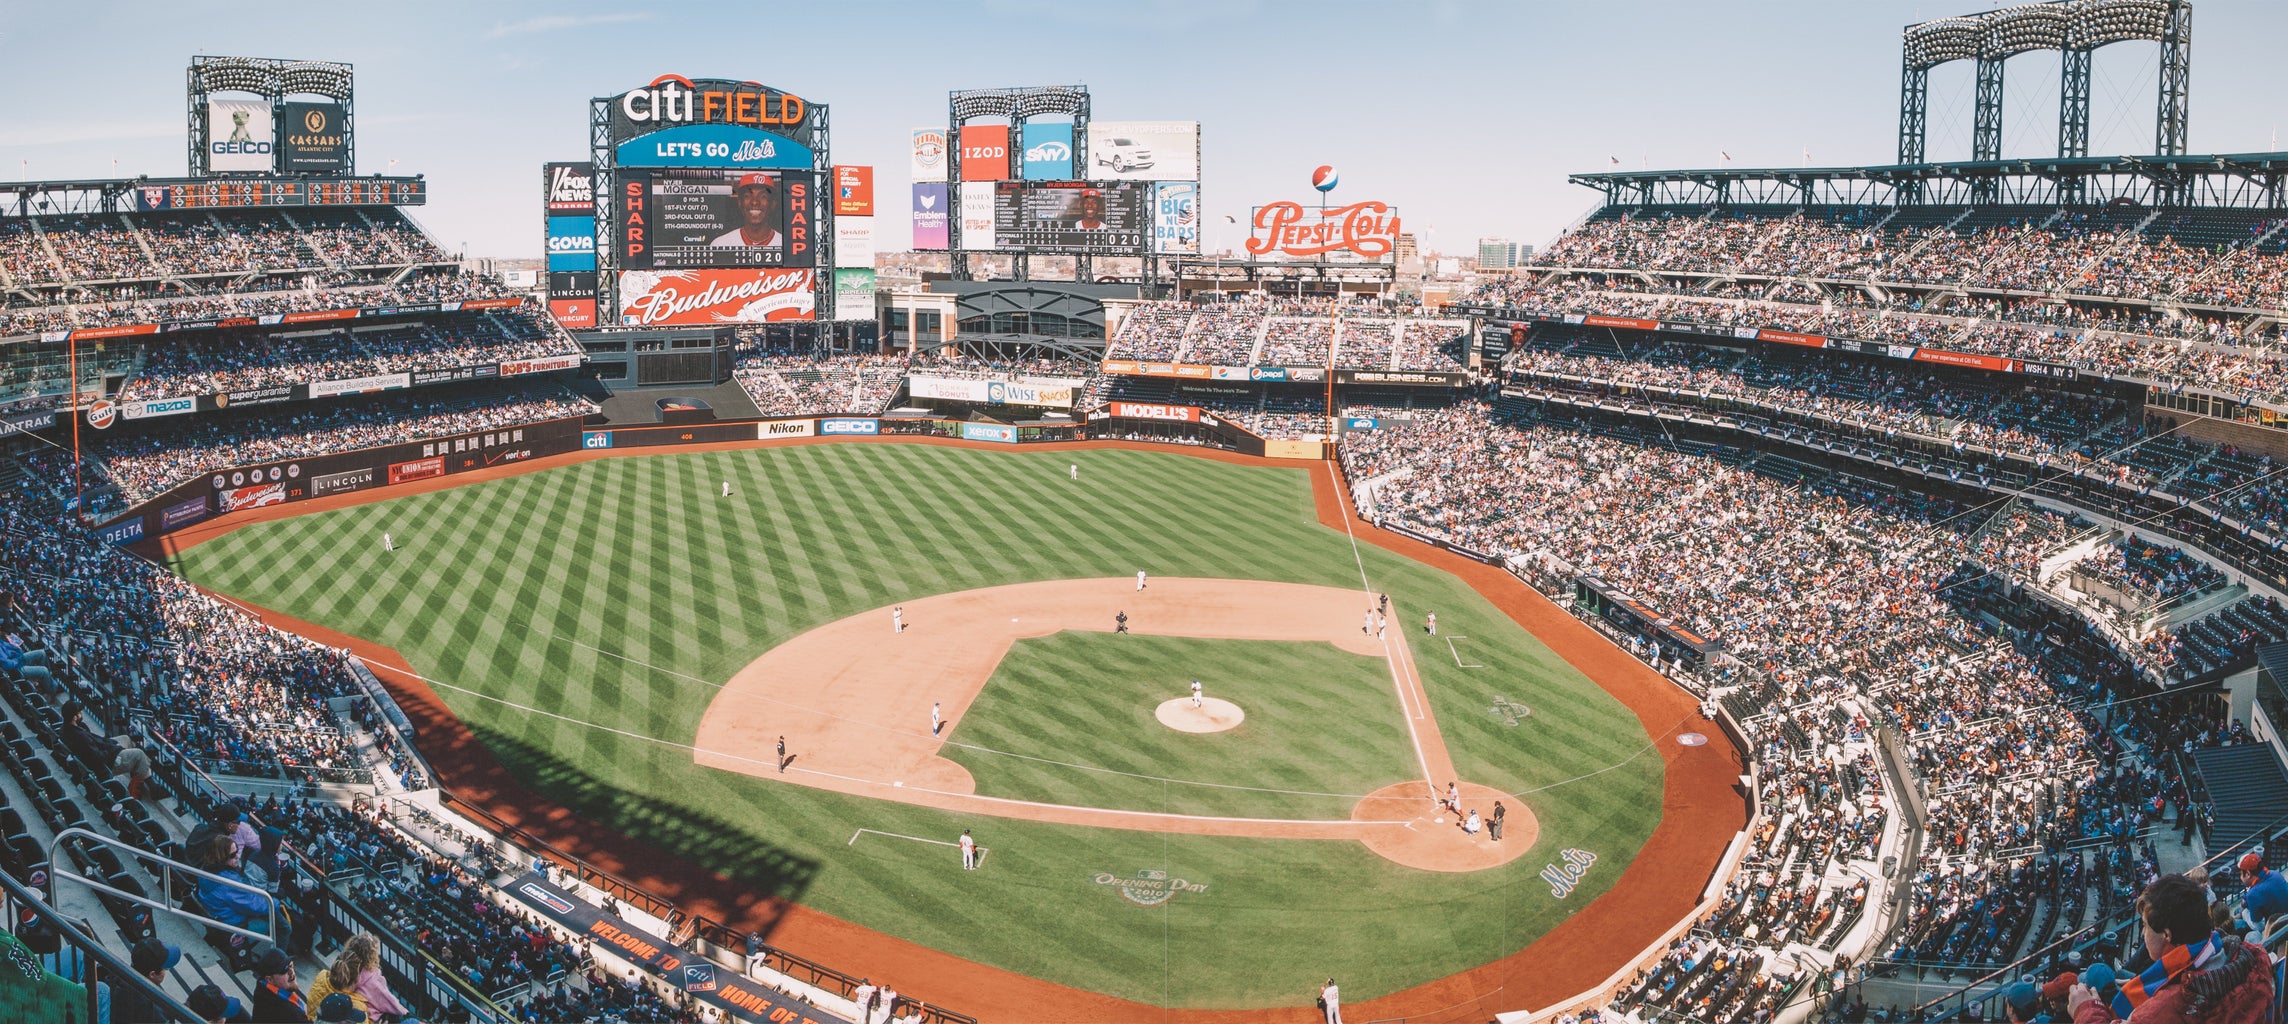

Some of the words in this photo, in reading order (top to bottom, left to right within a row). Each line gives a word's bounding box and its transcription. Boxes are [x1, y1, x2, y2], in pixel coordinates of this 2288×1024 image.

[622, 80, 693, 122] citi
[703, 91, 805, 125] FIELD
[289, 135, 342, 146] CAESARS
[916, 133, 943, 146] TITAN
[212, 141, 271, 154] GEICO
[657, 142, 701, 157] LET'S
[706, 143, 729, 157] GO
[732, 139, 776, 161] Mets
[964, 146, 1005, 159] IZOD
[1025, 147, 1067, 162] SNY
[564, 176, 591, 190] FOX
[663, 185, 709, 194] MORGAN
[556, 189, 592, 201] NEWS
[1161, 198, 1192, 215] BIG
[626, 182, 645, 257] SHARP
[790, 183, 807, 256] SHARP
[913, 211, 947, 220] Emblem
[917, 219, 943, 228] Health
[1157, 226, 1195, 239] BARS
[549, 236, 593, 250] GOYA
[1109, 234, 1116, 245] 0
[1121, 234, 1128, 245] 2
[1132, 234, 1140, 245] 0
[755, 252, 761, 262] 0
[765, 252, 772, 262] 2
[775, 252, 782, 262] 0
[552, 289, 594, 297] LINCOLN
[634, 270, 804, 324] Budweiser
[557, 314, 590, 322] MERCURY
[501, 362, 531, 376] BOB'S
[532, 360, 570, 371] FURNITURE
[1105, 363, 1136, 371] SUBWAY
[1176, 367, 1208, 376] SUBWAY
[1262, 370, 1284, 379] pepsi
[2025, 364, 2042, 374] WSH
[2042, 365, 2048, 374] 4
[2053, 367, 2064, 377] NY
[2068, 368, 2073, 377] 3
[453, 371, 460, 379] At
[462, 371, 472, 379] Bat
[317, 381, 344, 393] Alliance
[346, 379, 374, 391] Building
[375, 376, 404, 387] Services
[228, 386, 292, 401] superguarantee
[939, 390, 970, 398] DONUTS
[146, 399, 191, 414] mazda
[1120, 404, 1189, 420] MODELL'S
[90, 407, 113, 422] Gulf
[768, 422, 804, 434] Nikon
[823, 421, 876, 432] GEICO
[968, 426, 1000, 438] xerox
[587, 434, 607, 448] citi
[505, 449, 531, 460] verizon
[402, 463, 421, 474] UNION
[319, 474, 373, 489] LINCOLN
[227, 482, 286, 511] Budweiser
[290, 489, 302, 497] 371
[106, 523, 143, 544] DELTA
[1540, 848, 1597, 898] Mets
[1095, 872, 1164, 889] OPENING
[1167, 878, 1208, 893] DAY
[523, 886, 571, 912] mets.com
[1135, 889, 1164, 897] 2010
[590, 920, 660, 960] WELCOME
[655, 953, 680, 972] TO
[687, 966, 710, 983] citi
[688, 981, 714, 991] FIELD
[718, 984, 769, 1016] HOME
[769, 1006, 798, 1024] OF
